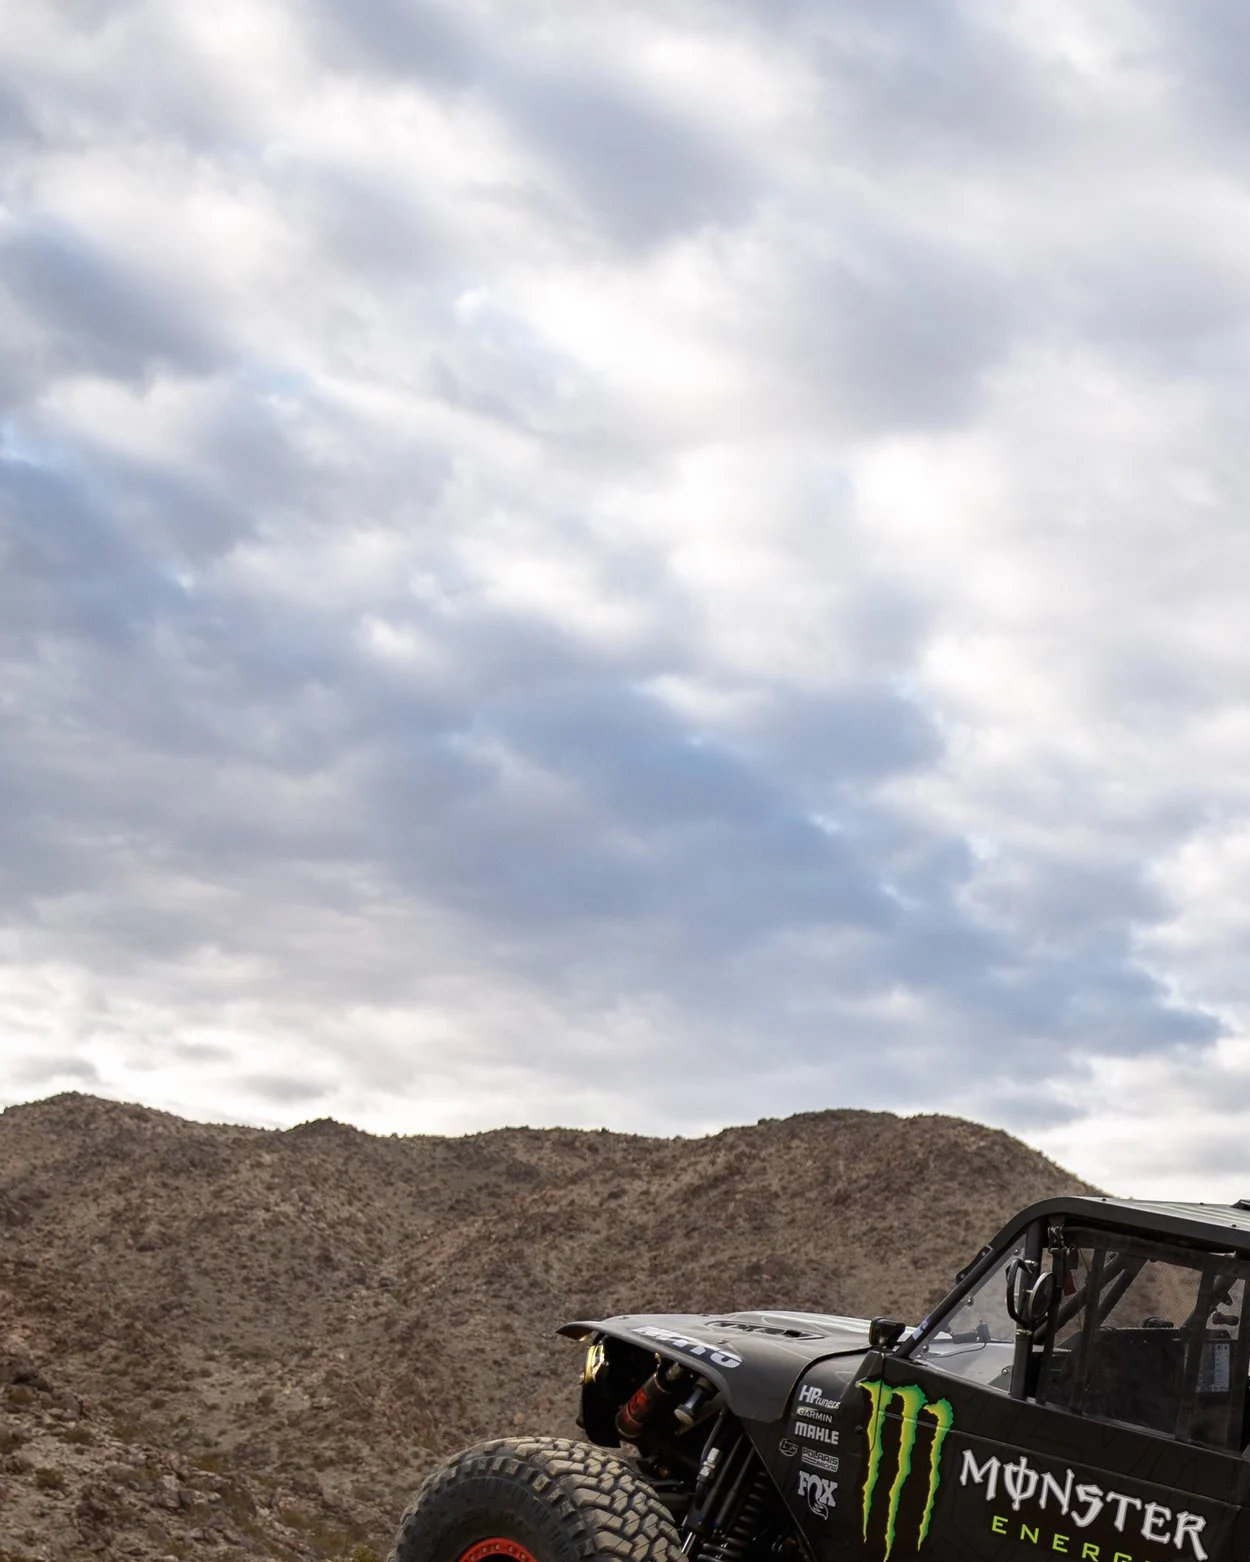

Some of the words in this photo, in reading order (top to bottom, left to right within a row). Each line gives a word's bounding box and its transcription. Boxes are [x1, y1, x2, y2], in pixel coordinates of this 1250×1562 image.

[798, 1407, 833, 1422] GARMIN
[795, 1421, 839, 1445] MAHLE
[797, 1470, 838, 1512] FOX
